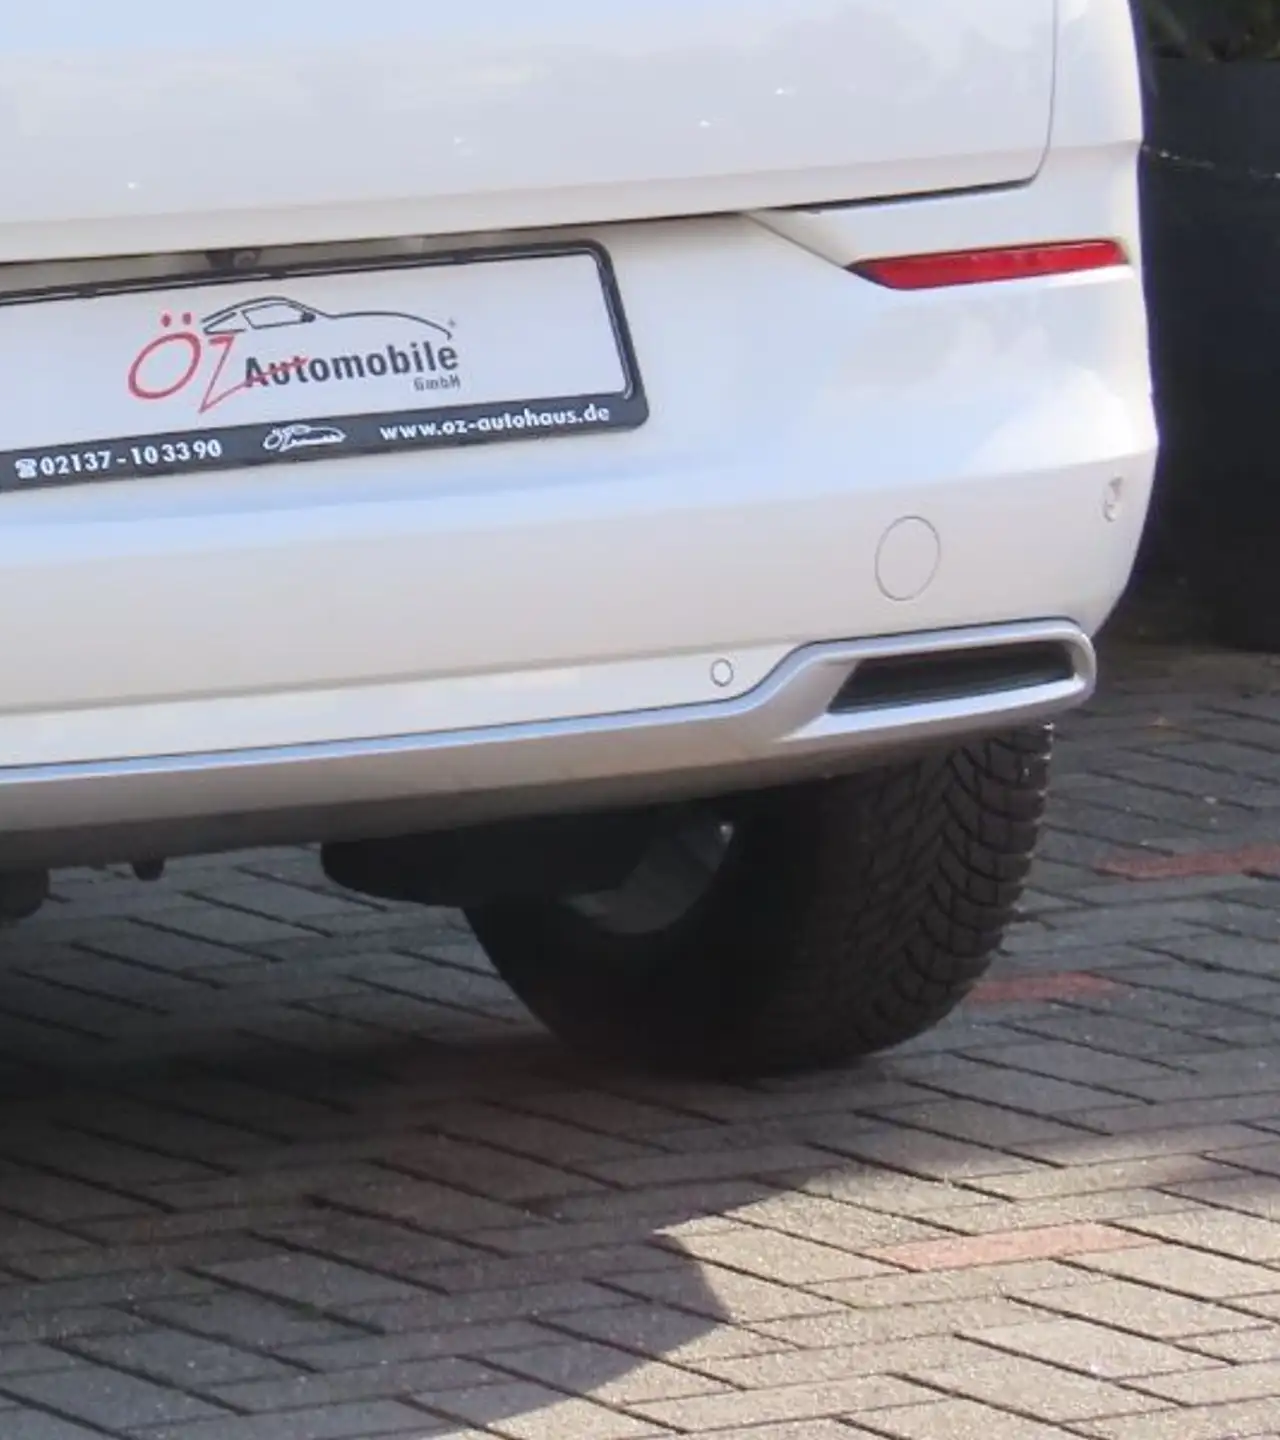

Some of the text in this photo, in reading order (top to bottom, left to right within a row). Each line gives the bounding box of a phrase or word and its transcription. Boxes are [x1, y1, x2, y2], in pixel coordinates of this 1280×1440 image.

[243, 341, 459, 387] Automobile
[412, 374, 462, 392] GmbH
[379, 403, 611, 442] www.oz-autohaus.de
